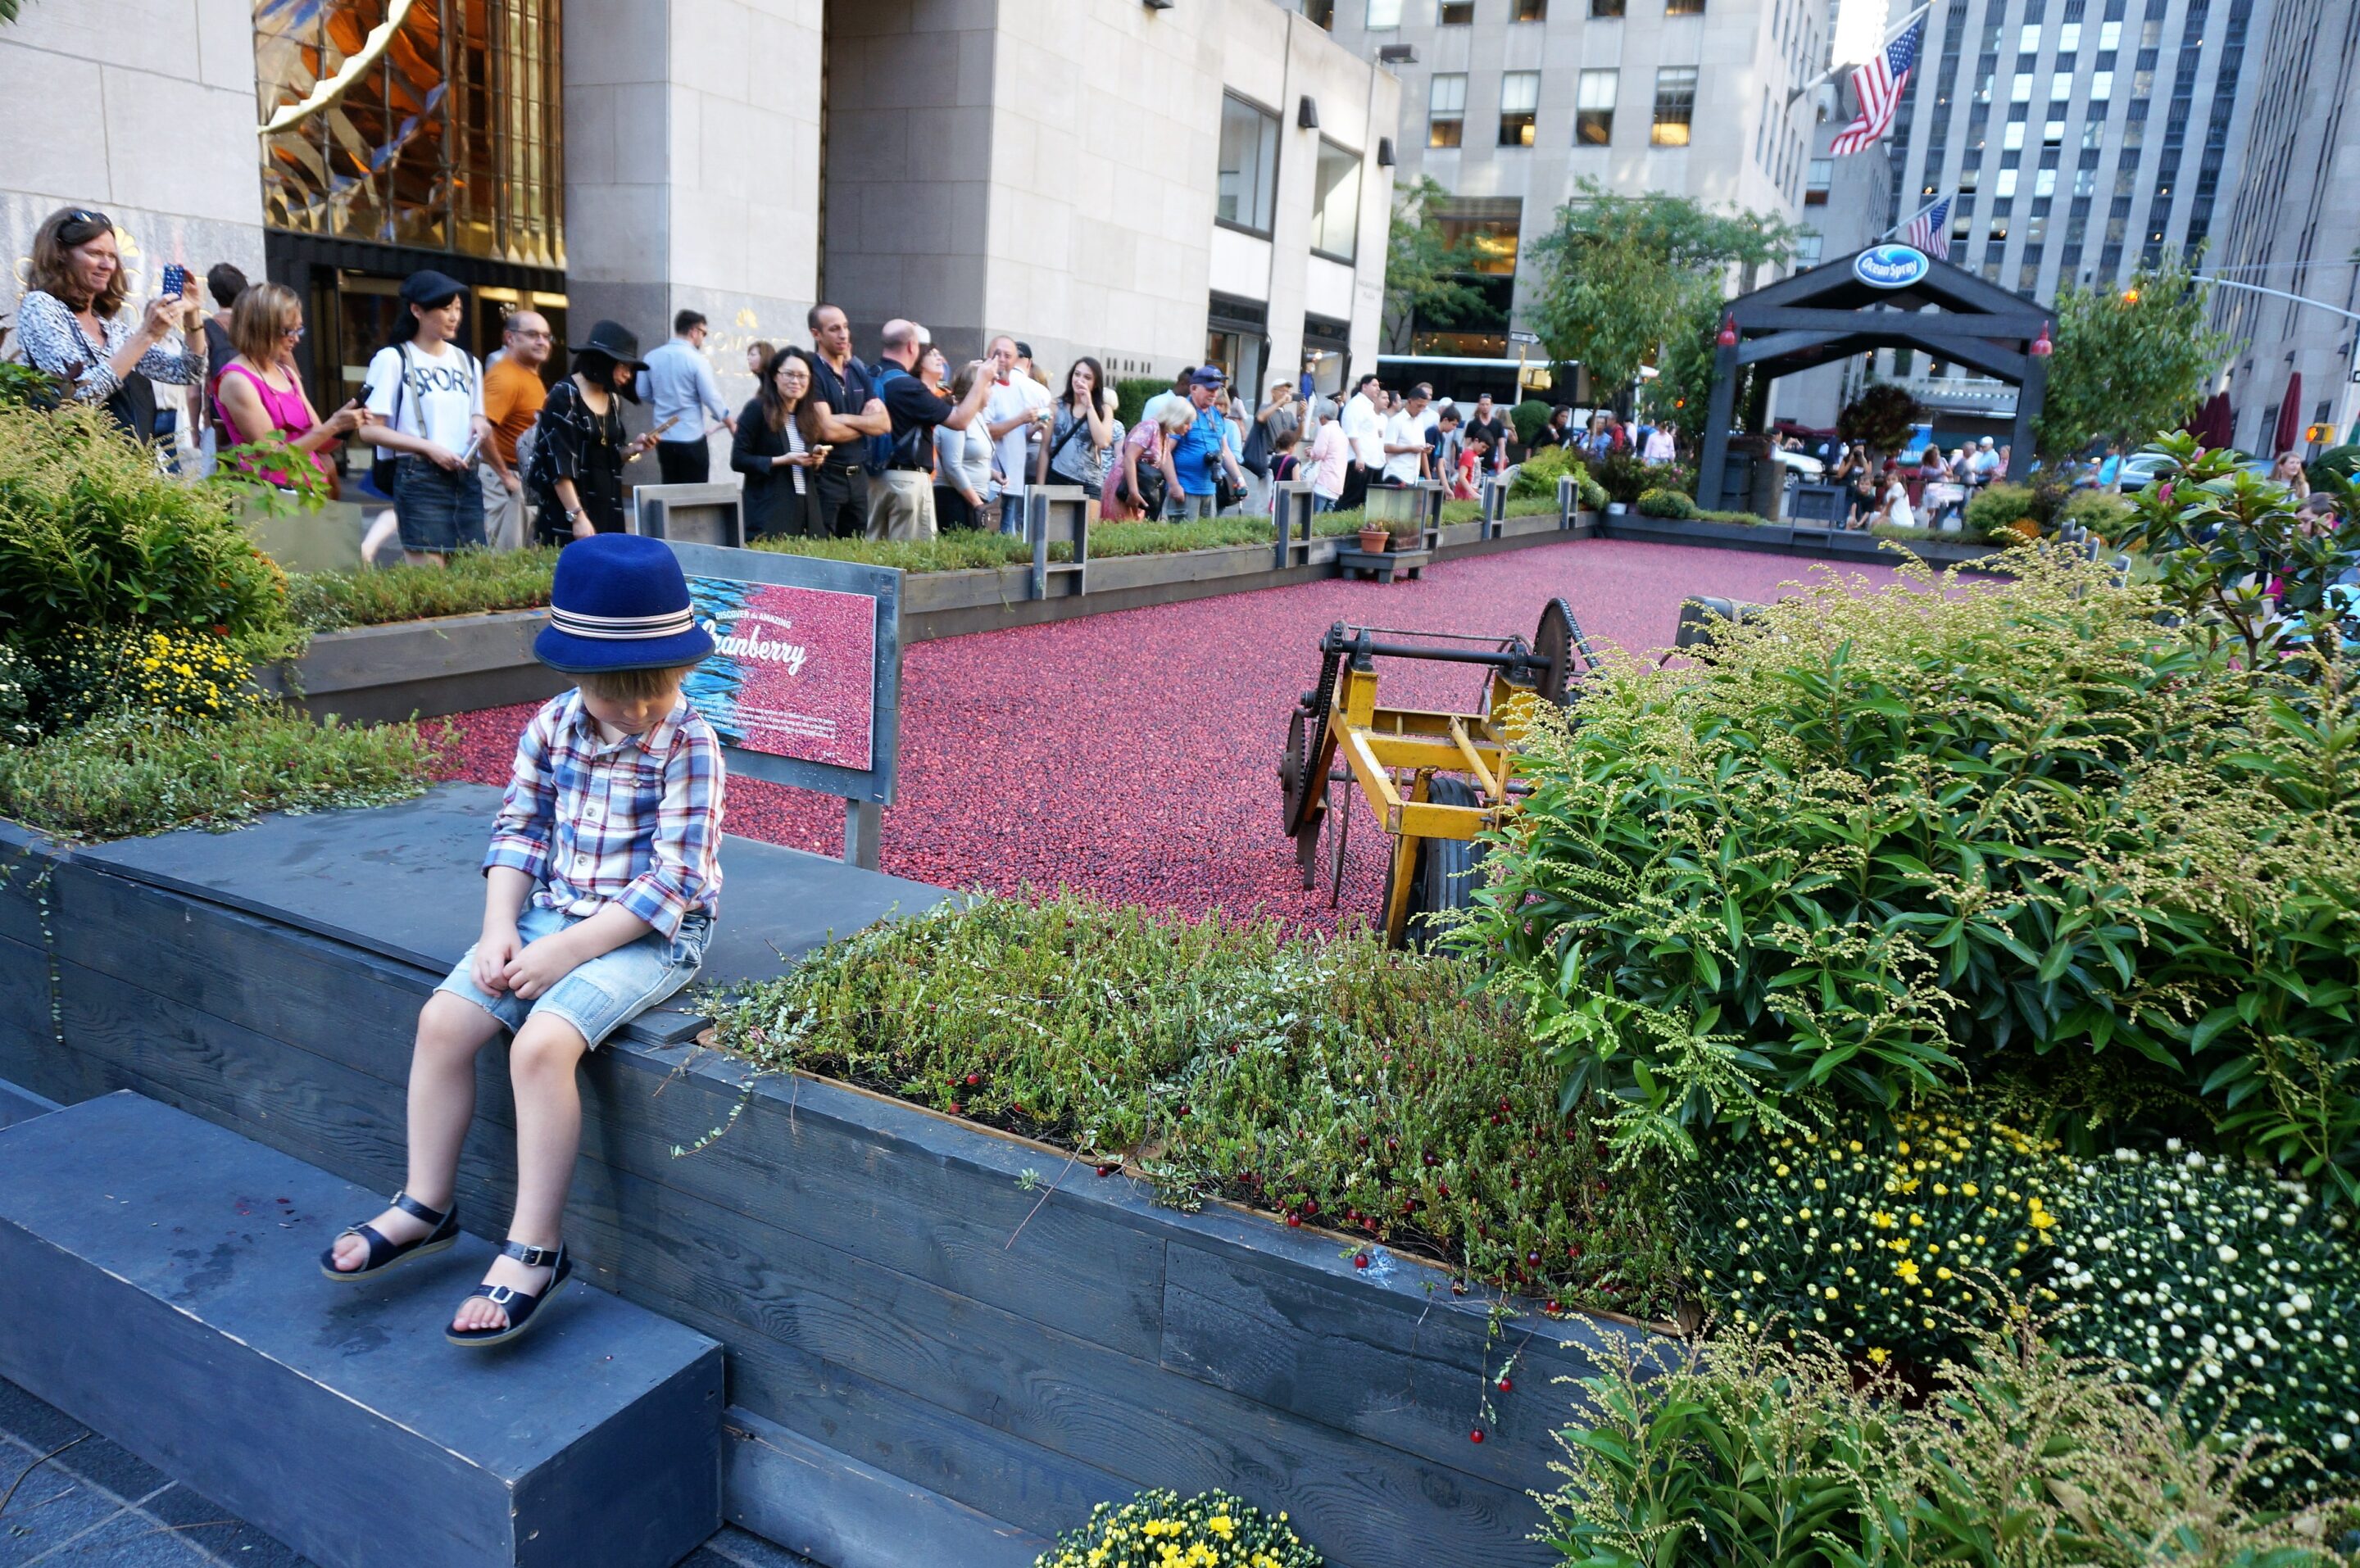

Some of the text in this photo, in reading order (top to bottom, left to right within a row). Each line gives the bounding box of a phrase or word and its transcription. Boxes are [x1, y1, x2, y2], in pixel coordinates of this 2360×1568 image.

[1862, 257, 1918, 279] Ocean Spray
[402, 366, 473, 397] SPOR
[715, 610, 749, 620] DISCOVER
[759, 613, 792, 629] AMAZING
